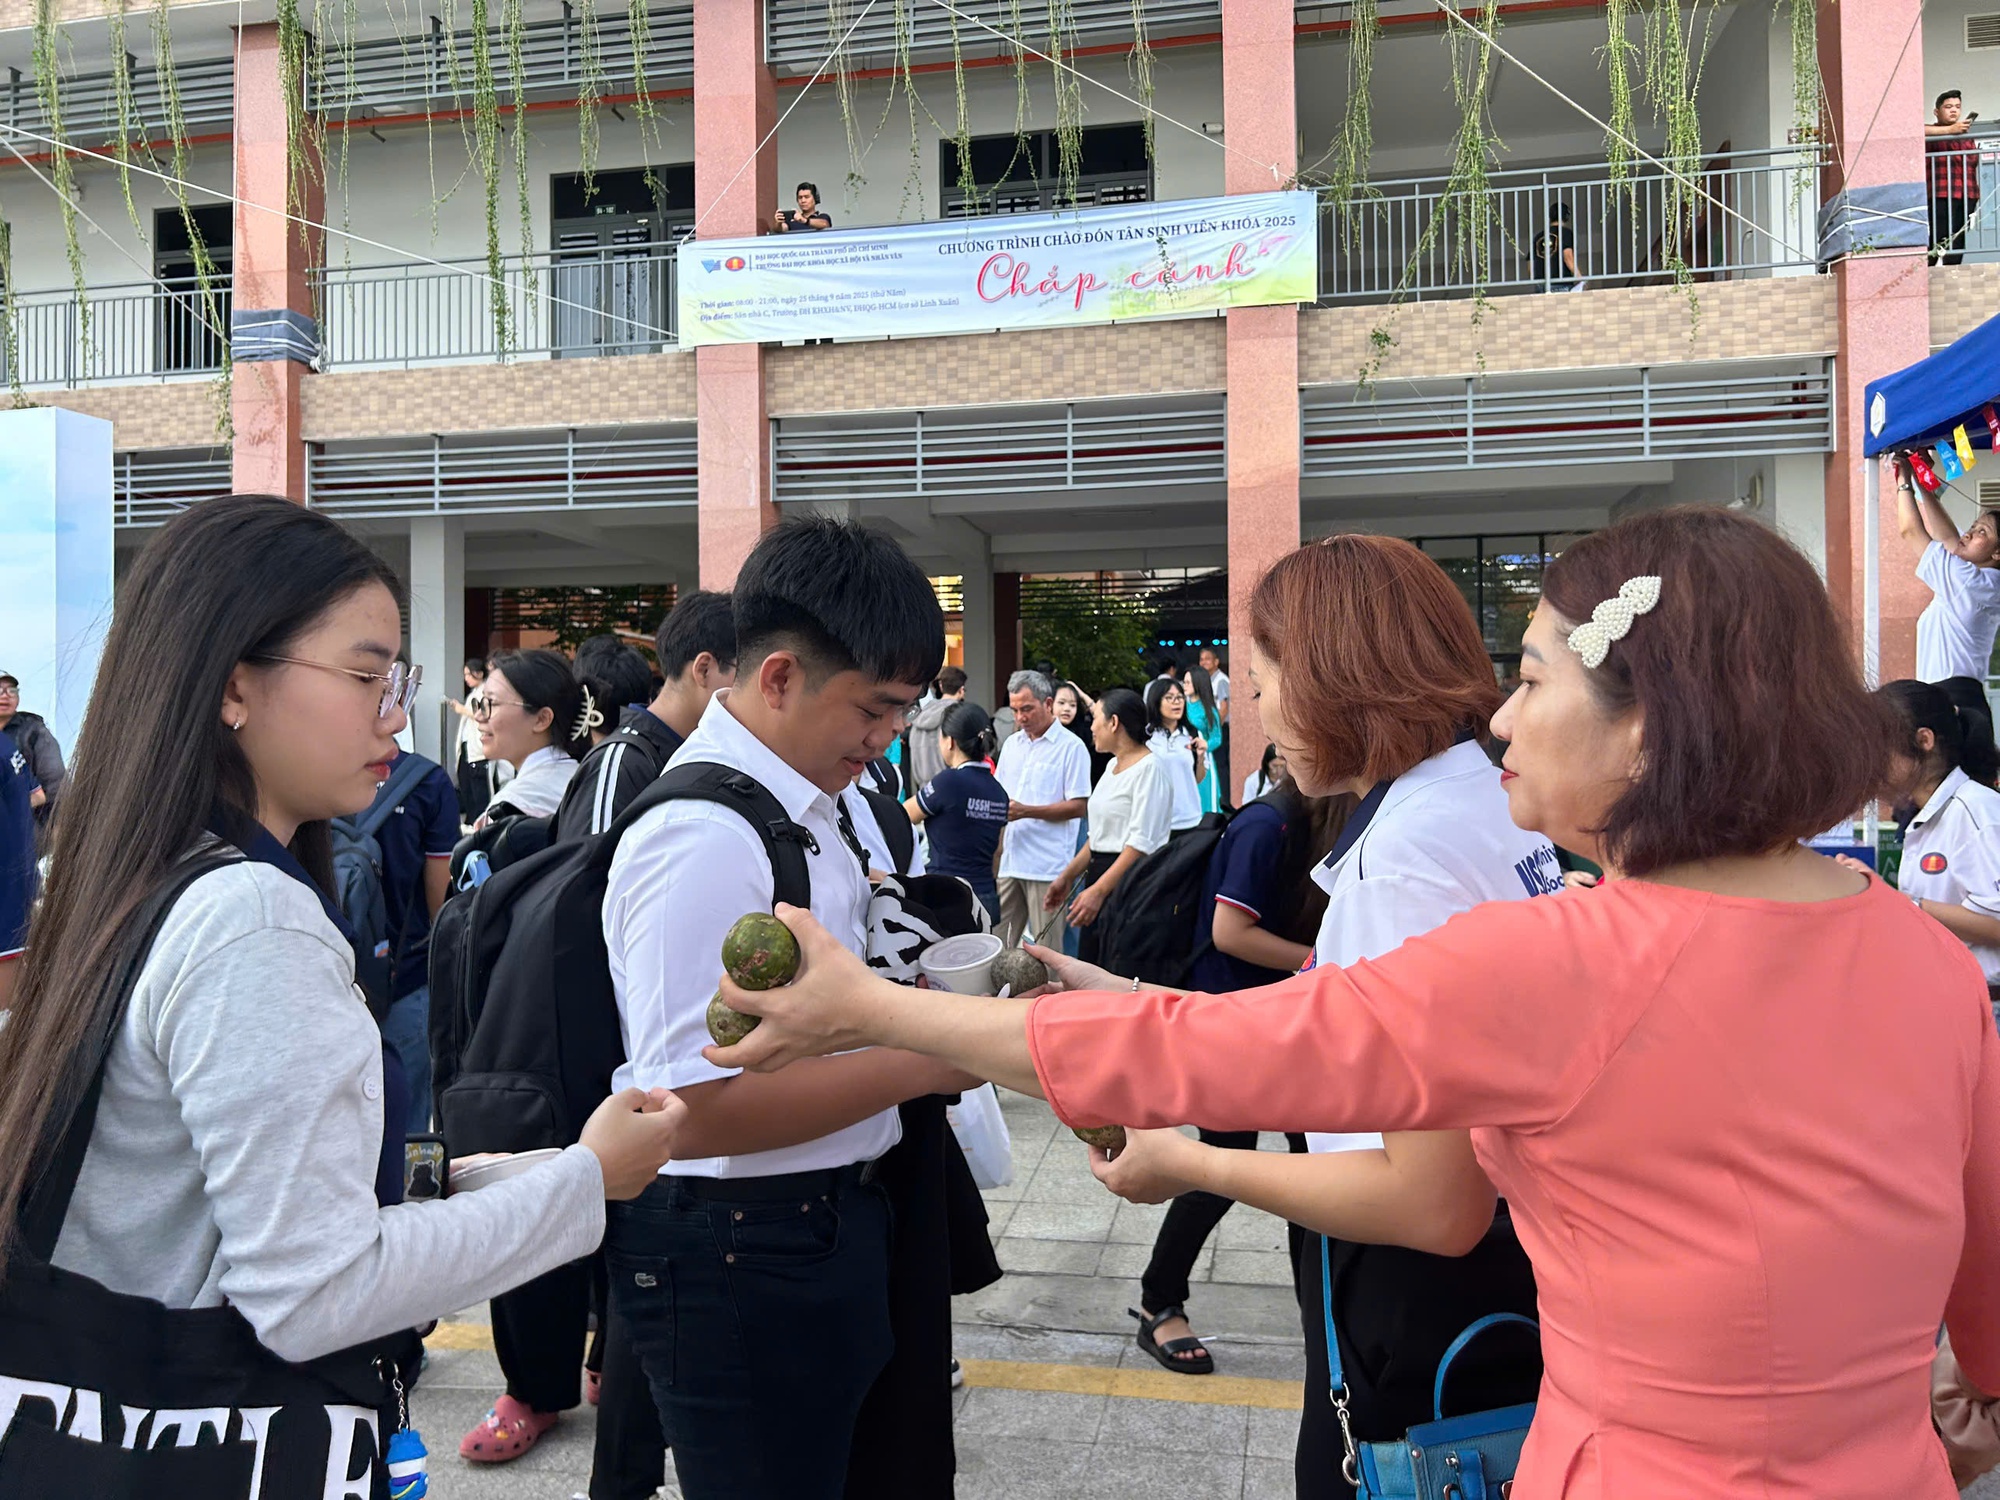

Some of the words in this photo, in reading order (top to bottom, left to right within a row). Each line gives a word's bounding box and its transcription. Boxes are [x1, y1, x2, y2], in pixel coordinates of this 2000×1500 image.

[938, 240, 994, 255] CHƯƠNG
[997, 235, 1040, 250] TRÌNH
[1043, 231, 1081, 247] CHÀO
[1084, 228, 1113, 244] ĐÓN
[1116, 224, 1144, 241] TÂN
[1147, 224, 1180, 239] SINH
[1184, 219, 1218, 234] VIÊN
[1221, 215, 1260, 231] KHÓA
[1264, 215, 1296, 227] 2025
[1123, 242, 1256, 290] cánh
[799, 295, 808, 303] 25
[853, 290, 869, 299] 2025
[968, 797, 990, 811] USSH
